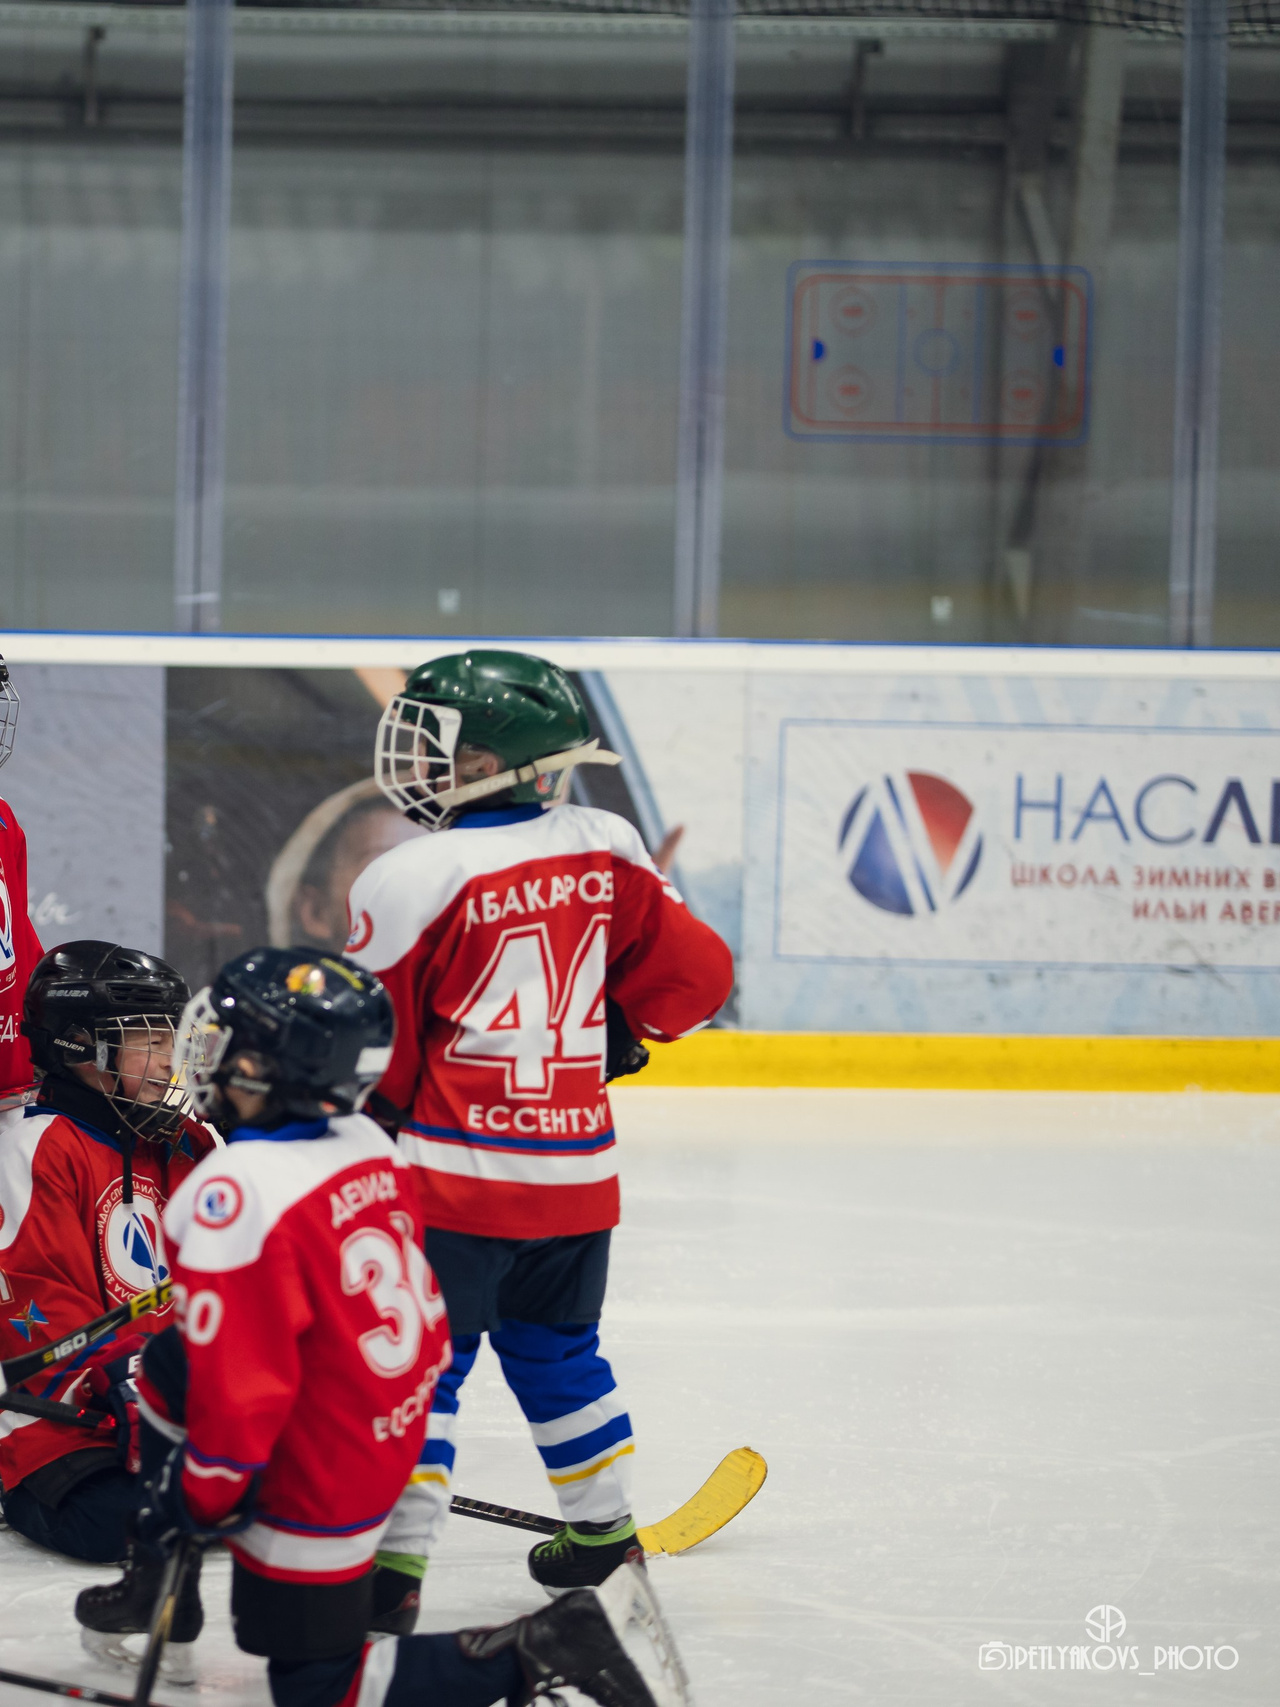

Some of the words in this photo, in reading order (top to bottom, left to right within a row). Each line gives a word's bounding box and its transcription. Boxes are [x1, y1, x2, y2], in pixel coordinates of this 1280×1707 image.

[1013, 772, 1280, 846] НАСЛ
[1010, 862, 1121, 890] ШКОЛА
[1131, 864, 1252, 892] ЗИМНИХ
[1131, 898, 1208, 923] ИЛЬИ
[444, 912, 613, 1100] 44
[53, 1037, 85, 1052] BAUER
[42, 1331, 88, 1364] S160
